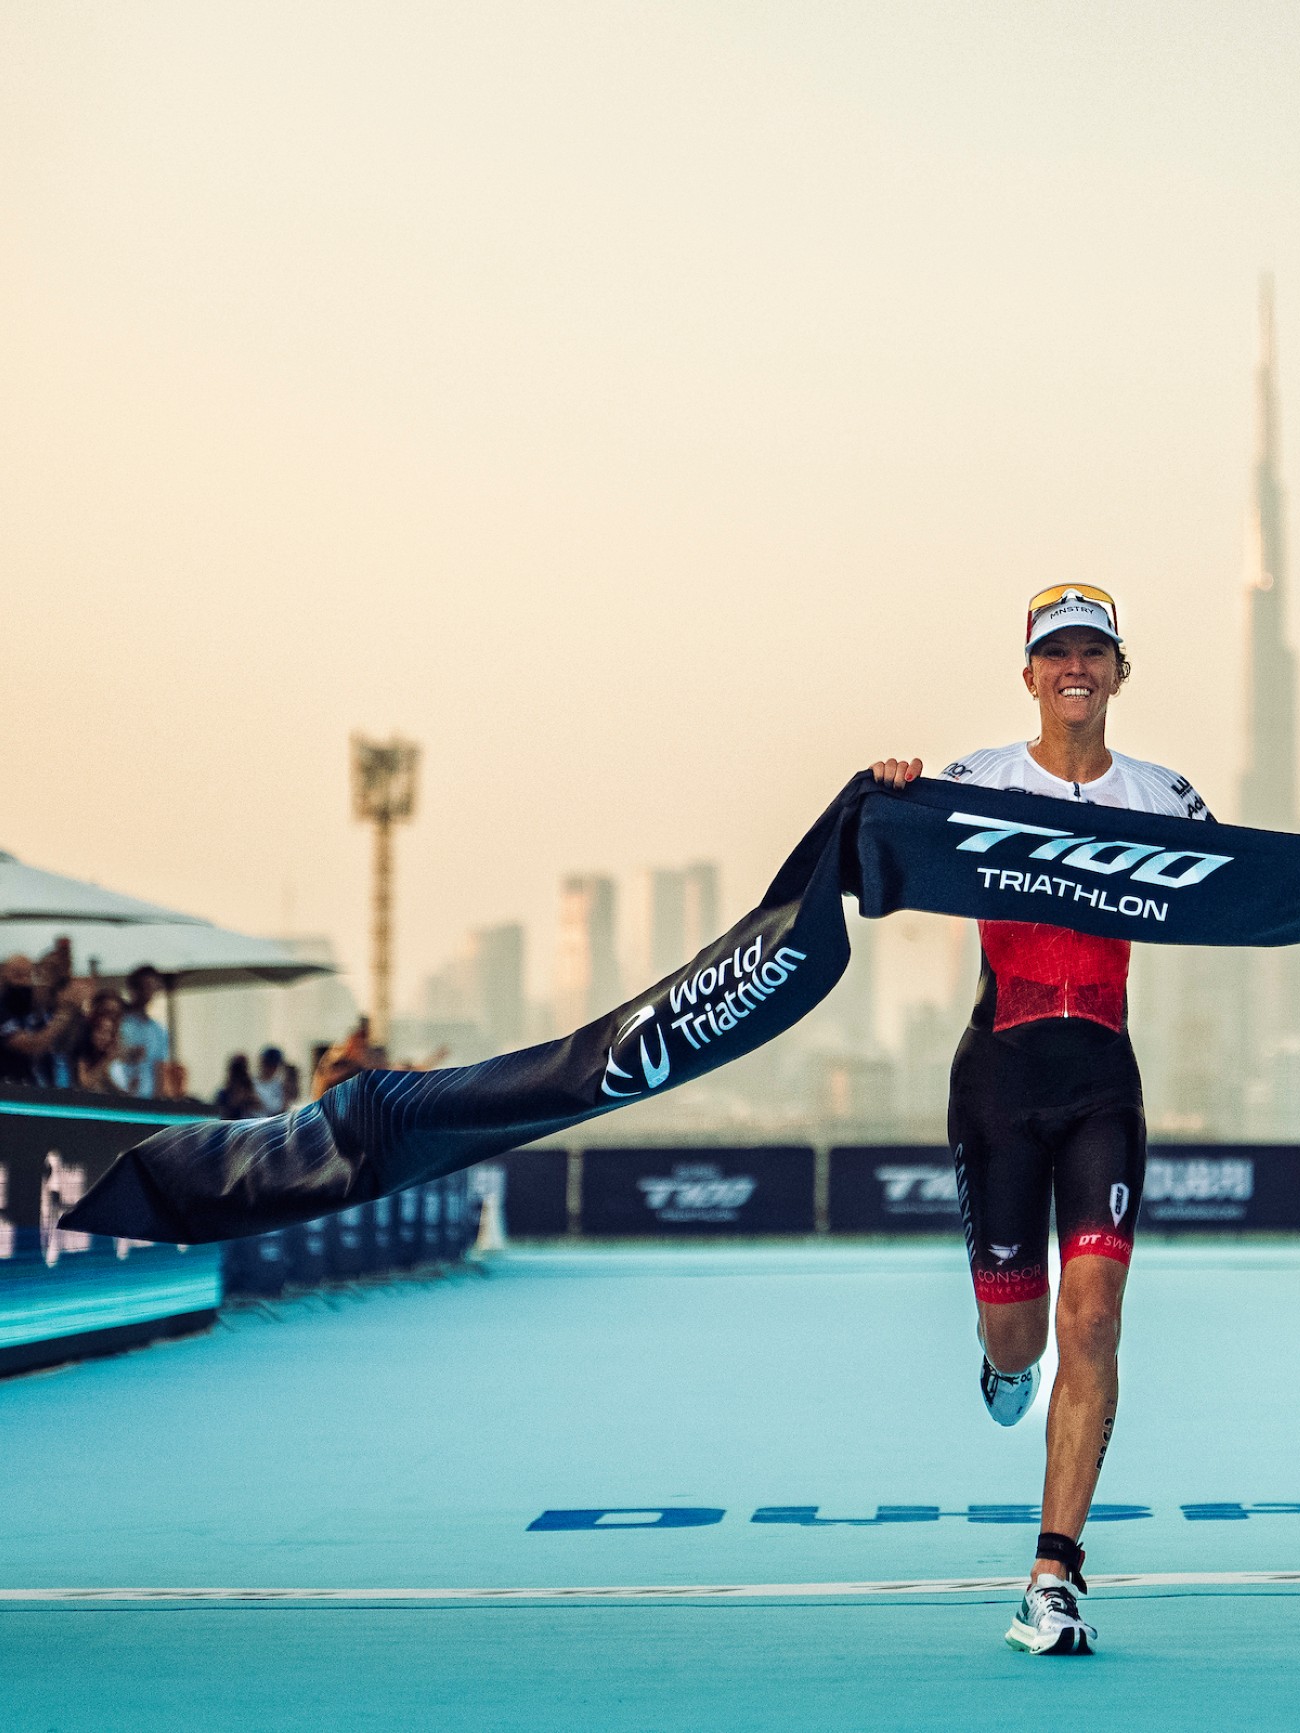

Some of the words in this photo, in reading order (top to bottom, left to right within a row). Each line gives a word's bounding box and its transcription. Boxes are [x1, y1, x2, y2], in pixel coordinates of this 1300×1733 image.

[1050, 606, 1094, 619] MNSTRY
[946, 811, 1235, 889] T100
[976, 867, 1169, 922] TRIATHLON
[669, 934, 763, 1014] World
[671, 947, 807, 1050] Triathlon
[1078, 1234, 1102, 1246] DT
